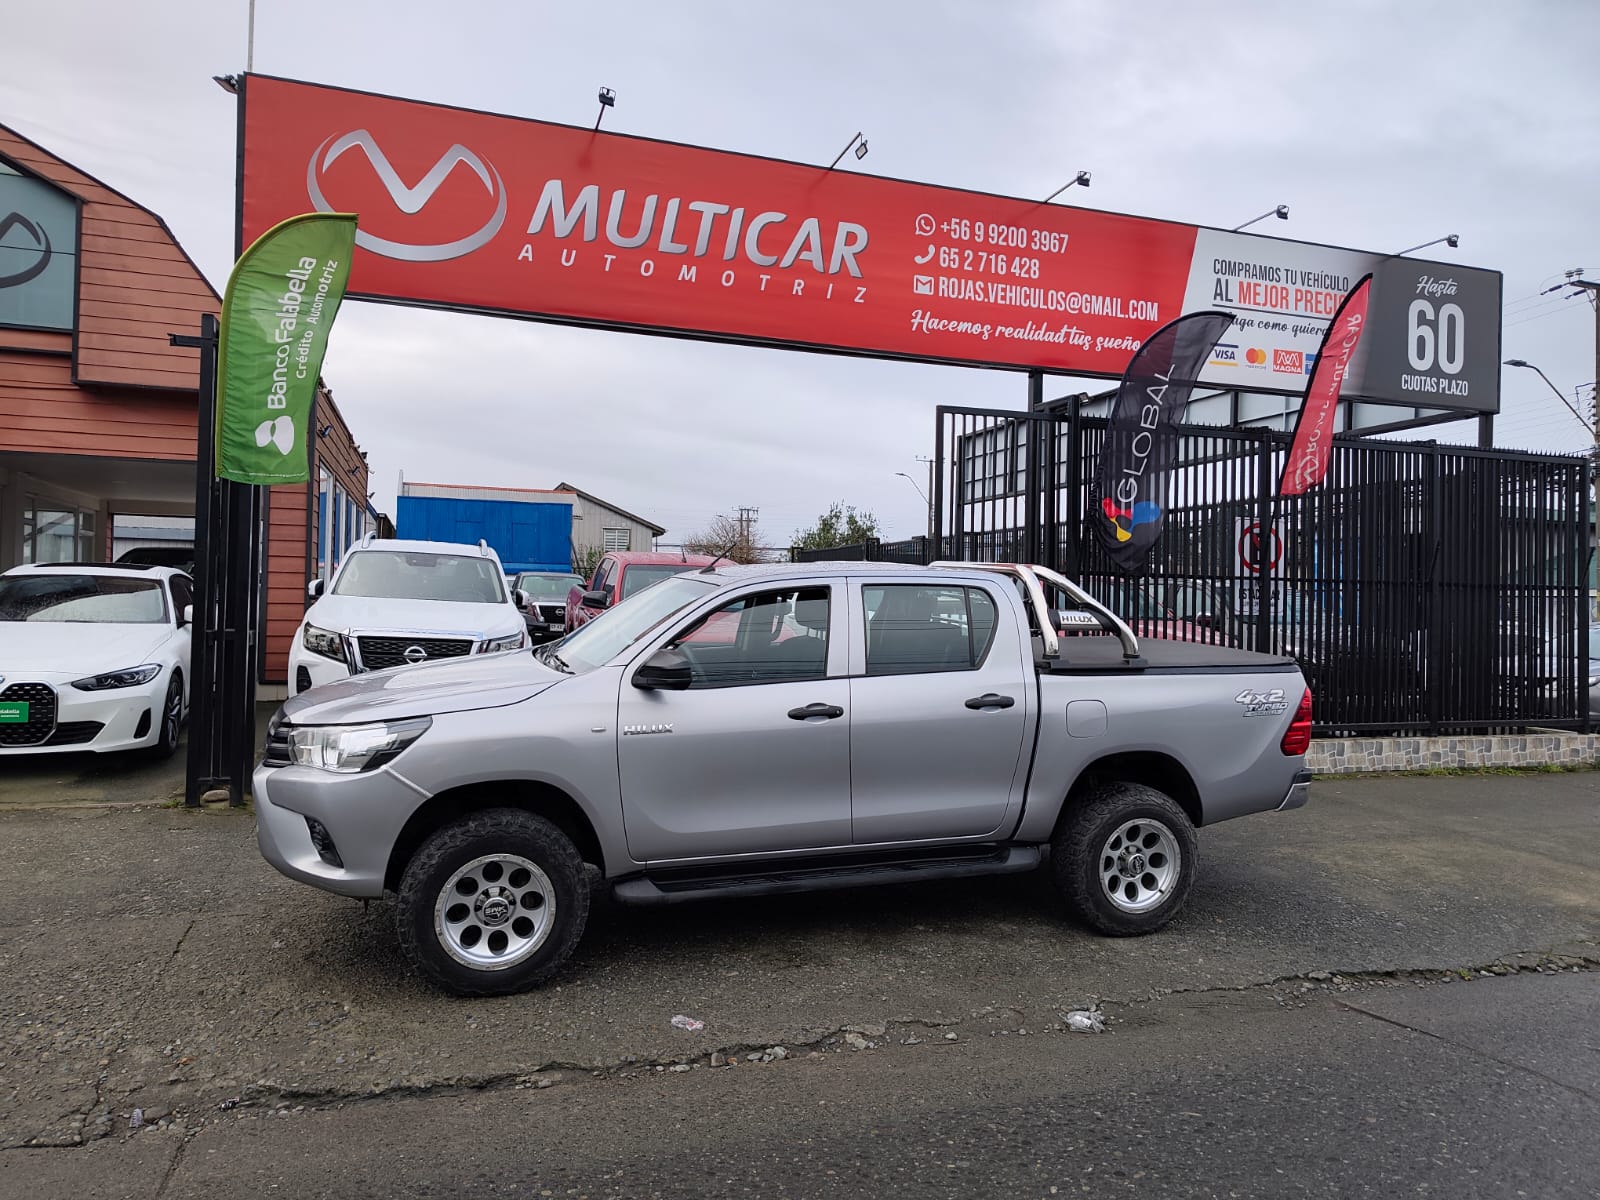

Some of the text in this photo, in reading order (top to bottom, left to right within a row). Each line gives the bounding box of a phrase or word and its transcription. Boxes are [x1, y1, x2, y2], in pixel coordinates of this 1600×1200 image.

[526, 179, 869, 278] MULTICAR
[940, 217, 1069, 254] +56 9 9200 3967
[518, 243, 868, 303] AUTOMOTRIZ
[939, 247, 1040, 279] 65 2 716 428
[1213, 258, 1349, 291] COMPRAMOS TU VEHÍCULO
[938, 275, 1159, 322] ROJAS.VEHICULOS@GMAIL.COM
[1213, 277, 1234, 303] AL
[1238, 281, 1290, 310] MEJOR
[1416, 275, 1458, 297] Hasta
[296, 259, 338, 379] Crédito Automotriz
[910, 308, 993, 340] Hacemos
[995, 321, 1067, 344] realidad
[1068, 328, 1093, 351] tus
[1257, 320, 1289, 331] como
[1407, 298, 1466, 375] 60
[1214, 349, 1236, 360] VISA
[1273, 364, 1302, 373] MAGNA
[1402, 374, 1469, 396] CUOTAS PLAZO
[1117, 363, 1176, 503] GLOBAL
[1061, 615, 1093, 623] HILUX
[1234, 688, 1286, 705] 4x2
[623, 723, 673, 735] HILUX
